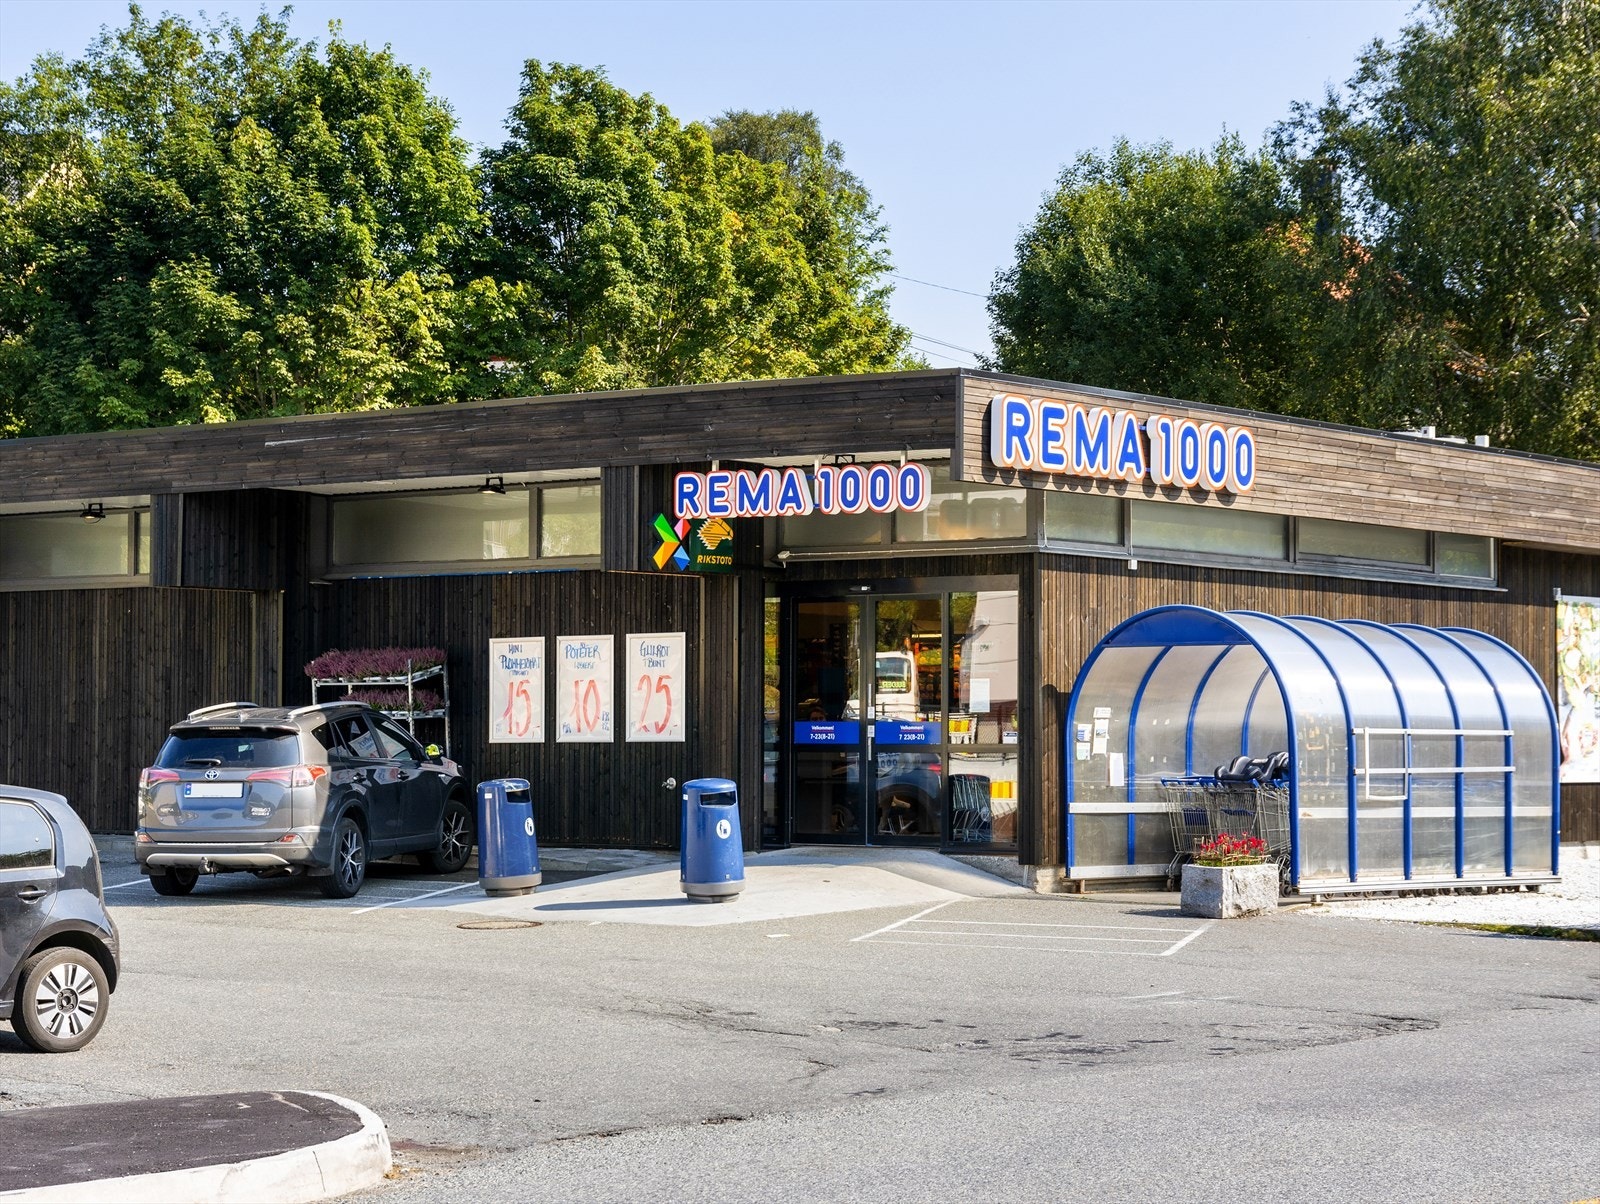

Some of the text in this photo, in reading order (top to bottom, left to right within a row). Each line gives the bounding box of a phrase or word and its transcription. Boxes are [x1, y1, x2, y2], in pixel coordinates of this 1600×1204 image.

[1004, 399, 1253, 489] REMA 1000
[676, 467, 922, 516] REMA 1000
[696, 554, 733, 565] RIKSTOTO
